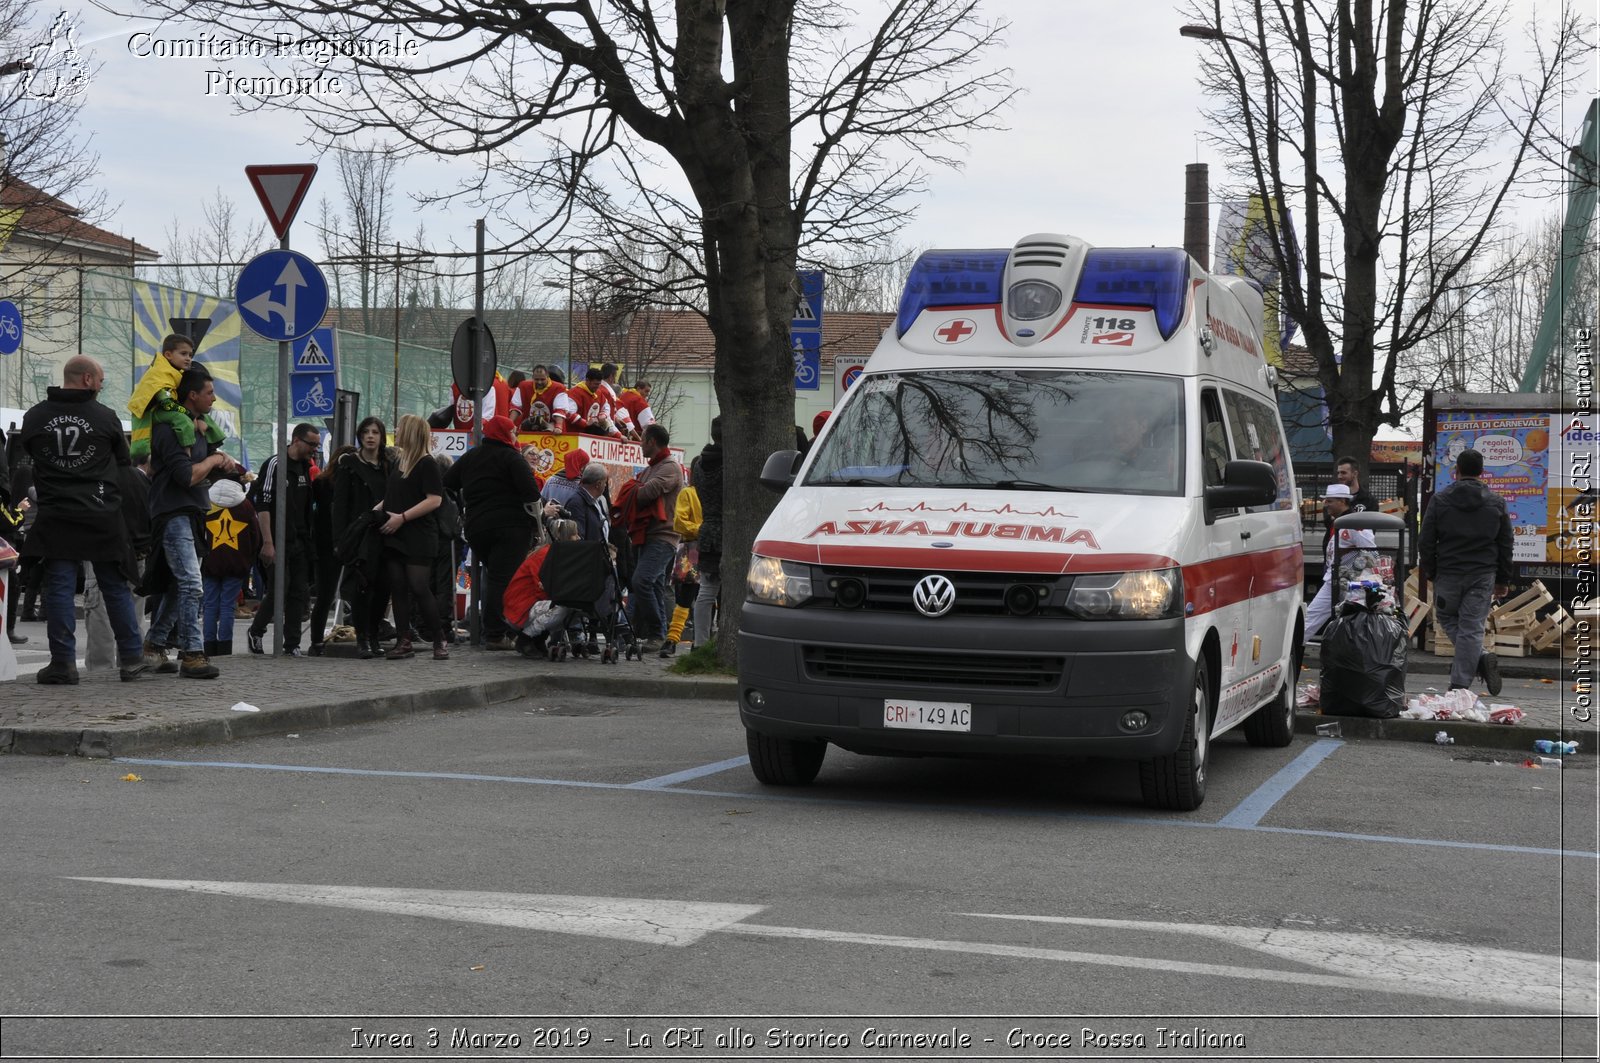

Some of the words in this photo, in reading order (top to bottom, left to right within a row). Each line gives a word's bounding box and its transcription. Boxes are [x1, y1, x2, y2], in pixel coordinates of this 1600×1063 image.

[1081, 316, 1092, 344] PIEMONTE
[1093, 317, 1136, 331] 118
[44, 415, 94, 434] DIFENSORI
[1442, 422, 1479, 430] OFFERTA
[1493, 419, 1545, 428] CARNEVALE
[53, 426, 81, 456] 12
[445, 435, 465, 451] 25
[590, 440, 605, 459] GLI
[50, 455, 66, 468] SAN
[68, 444, 96, 468] LORENZO
[1489, 447, 1514, 455] regala
[886, 705, 908, 723] CRI
[919, 707, 946, 724] 149
[950, 709, 969, 726] AC
